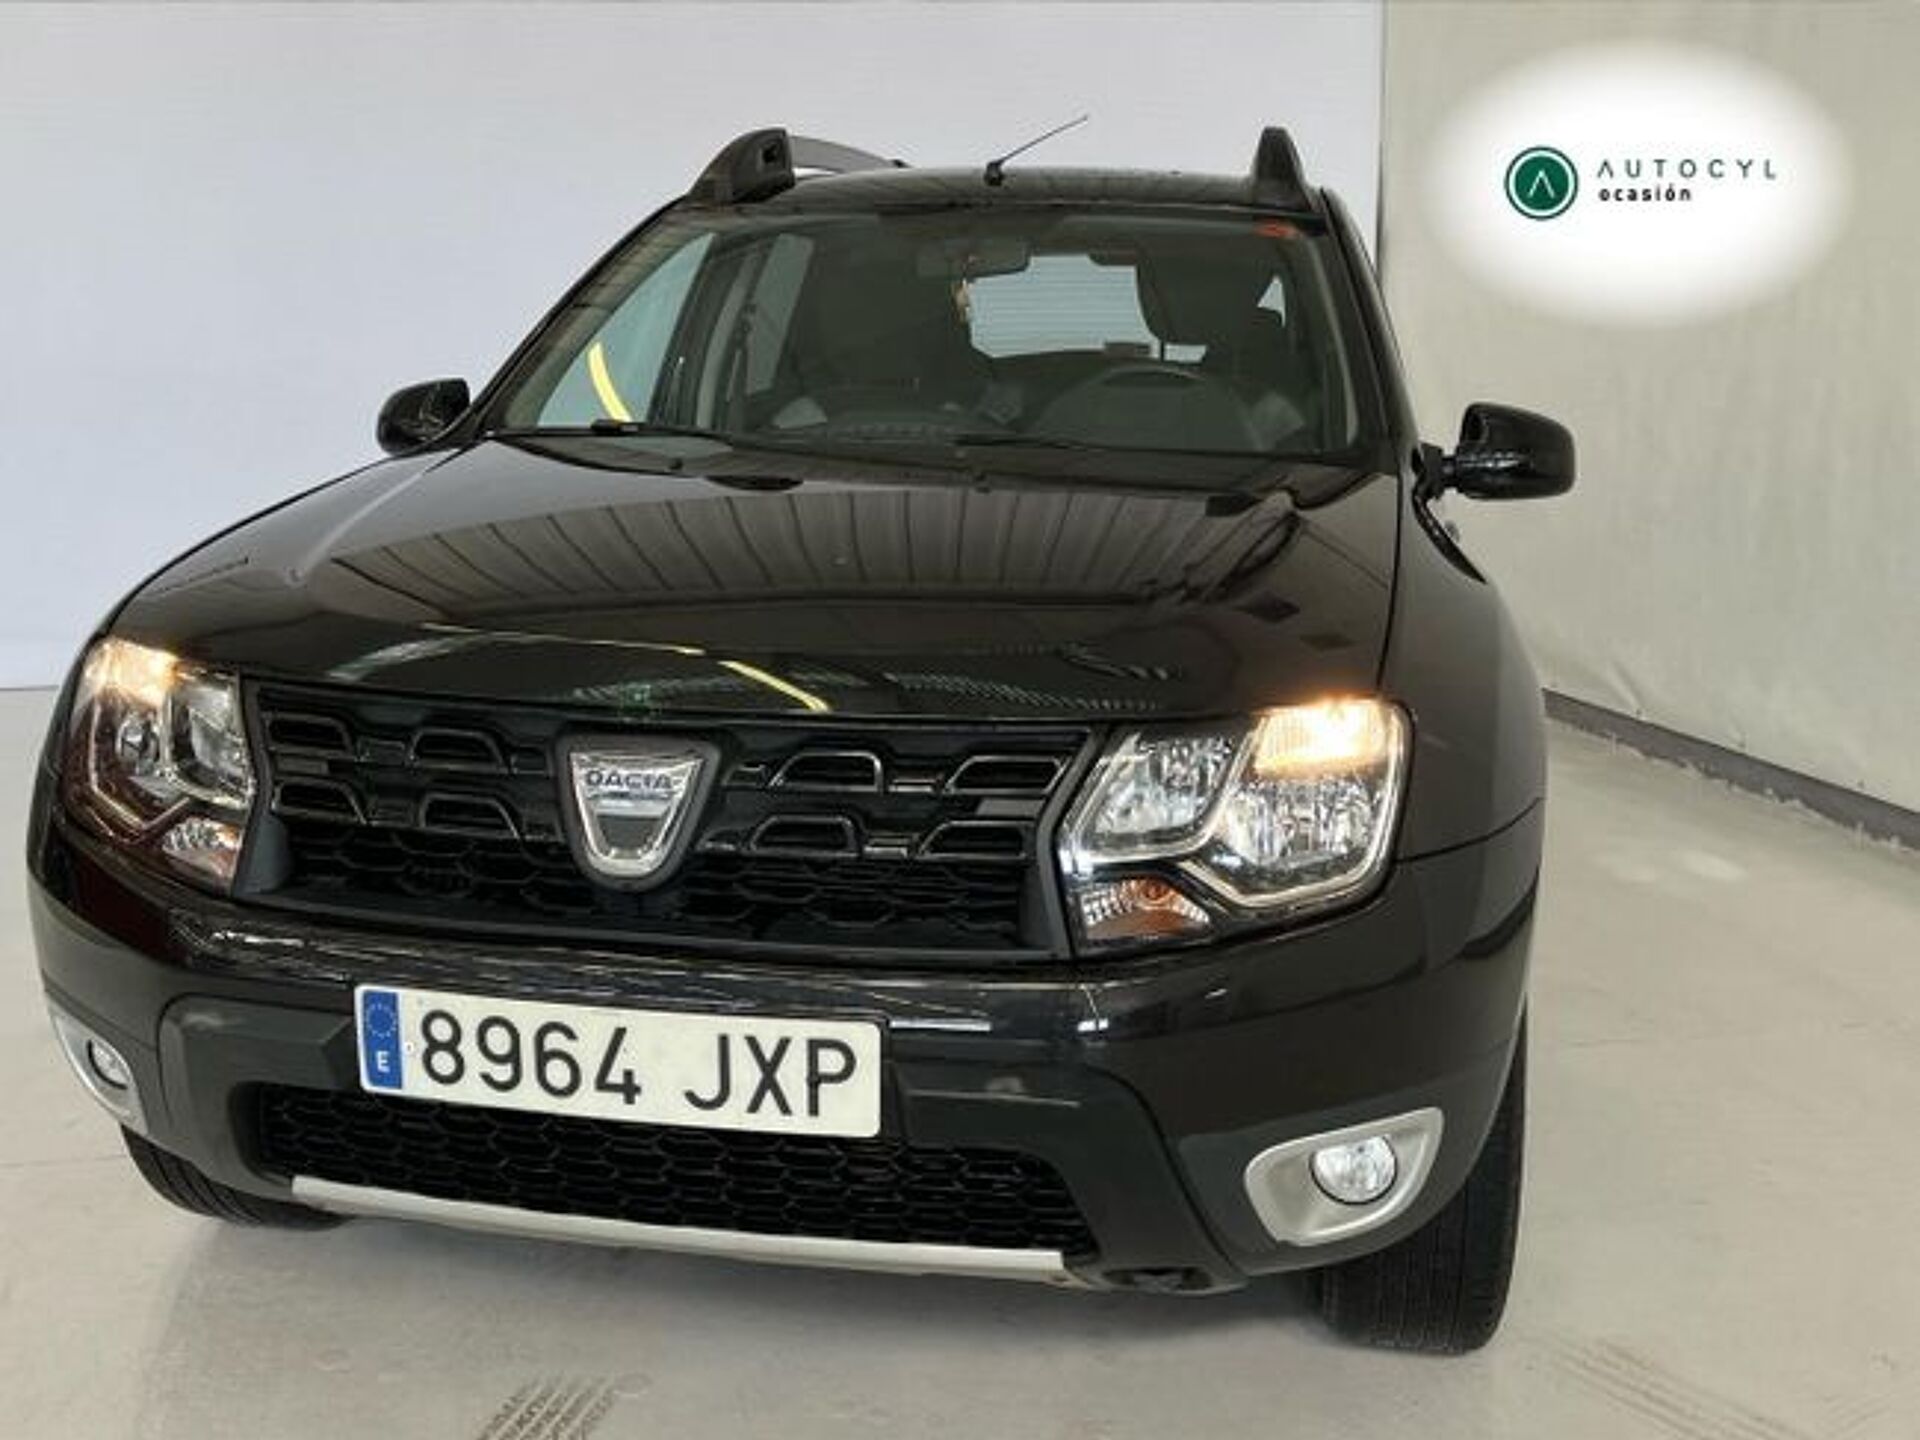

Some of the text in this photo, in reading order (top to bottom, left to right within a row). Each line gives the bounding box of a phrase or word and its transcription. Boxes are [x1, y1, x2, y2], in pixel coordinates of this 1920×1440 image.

[584, 769, 673, 790] DACIA
[375, 1051, 390, 1073] E
[420, 1009, 858, 1117] 8964 JXP
